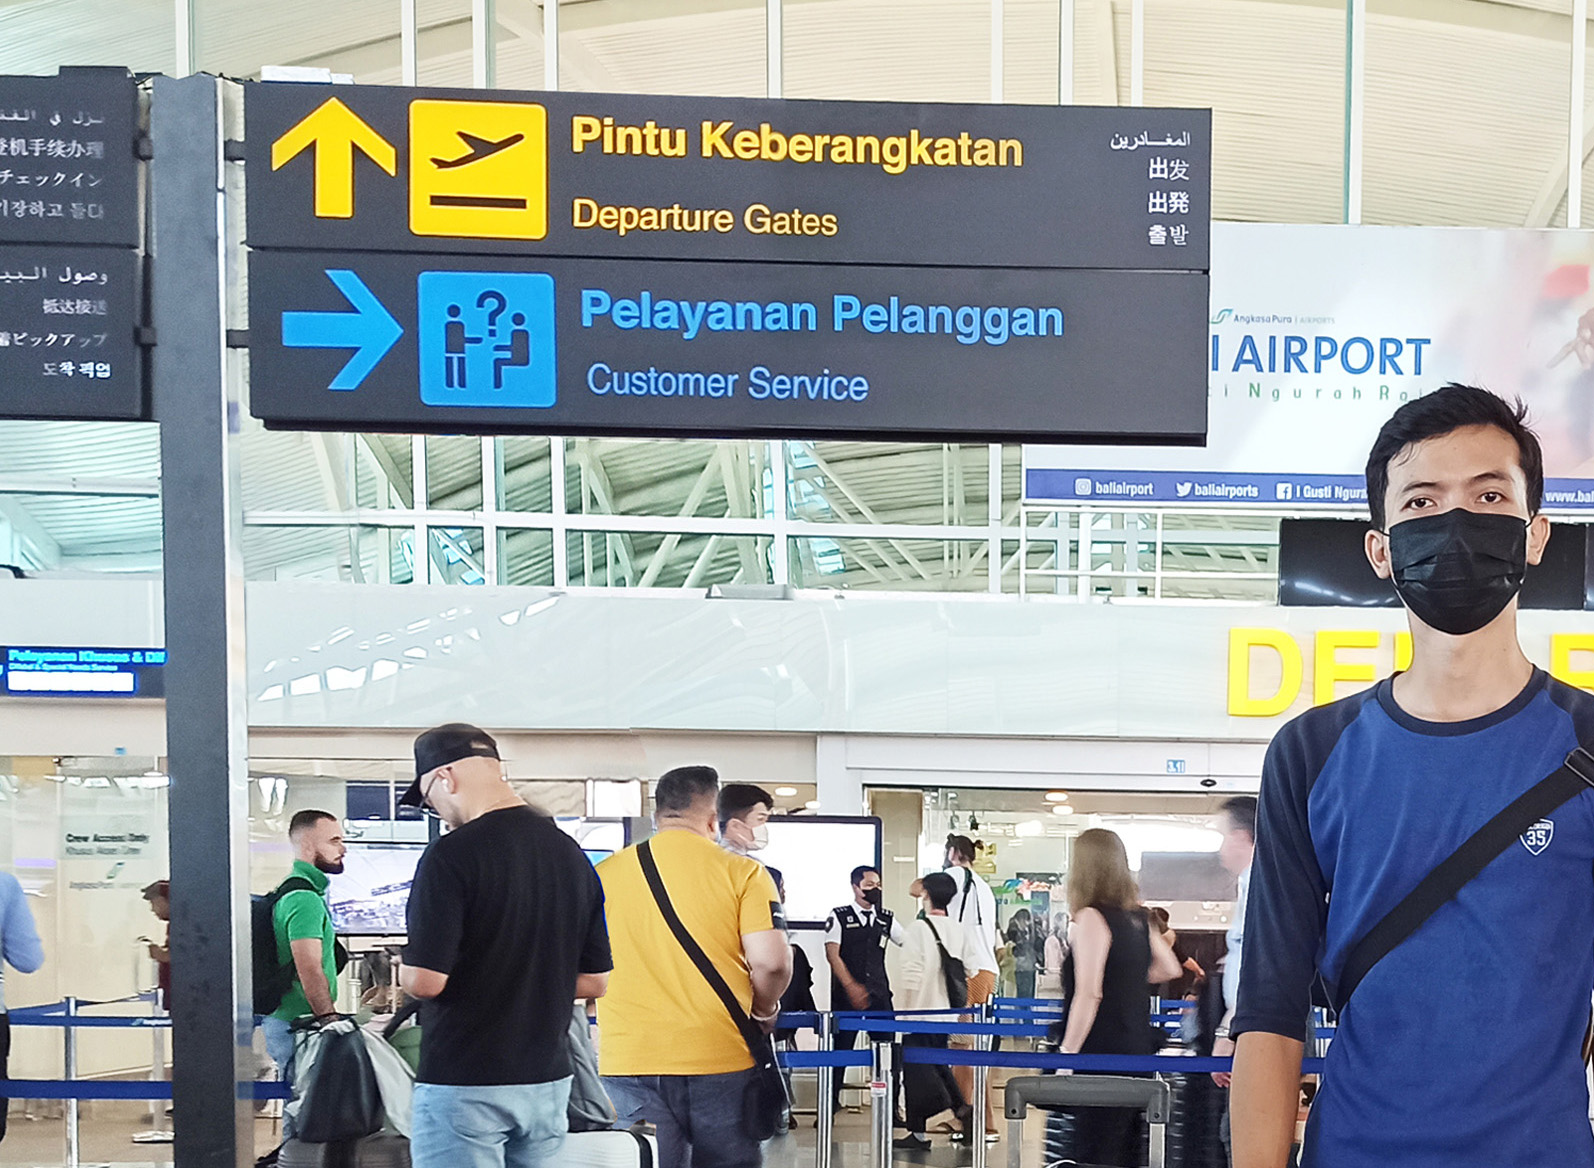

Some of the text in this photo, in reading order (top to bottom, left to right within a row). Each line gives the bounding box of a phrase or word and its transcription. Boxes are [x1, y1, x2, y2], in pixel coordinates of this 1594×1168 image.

[572, 116, 1024, 175] Pintu Keberangkatan
[1148, 156, 1190, 181] 出发
[1148, 190, 1190, 214] 出発
[572, 199, 838, 237] Departure Gates
[1148, 223, 1189, 246] 출발
[581, 290, 1064, 345] Pelayanan Pelanggan
[1231, 334, 1432, 377] AIRPORT
[587, 362, 870, 402] Customer Service
[1248, 382, 1362, 403] Ngurah
[1095, 481, 1154, 497] baliairport
[1194, 483, 1259, 499] baliairports
[1303, 485, 1332, 499] Gusti
[1334, 486, 1369, 501] Ngura
[1526, 830, 1546, 846] 35
